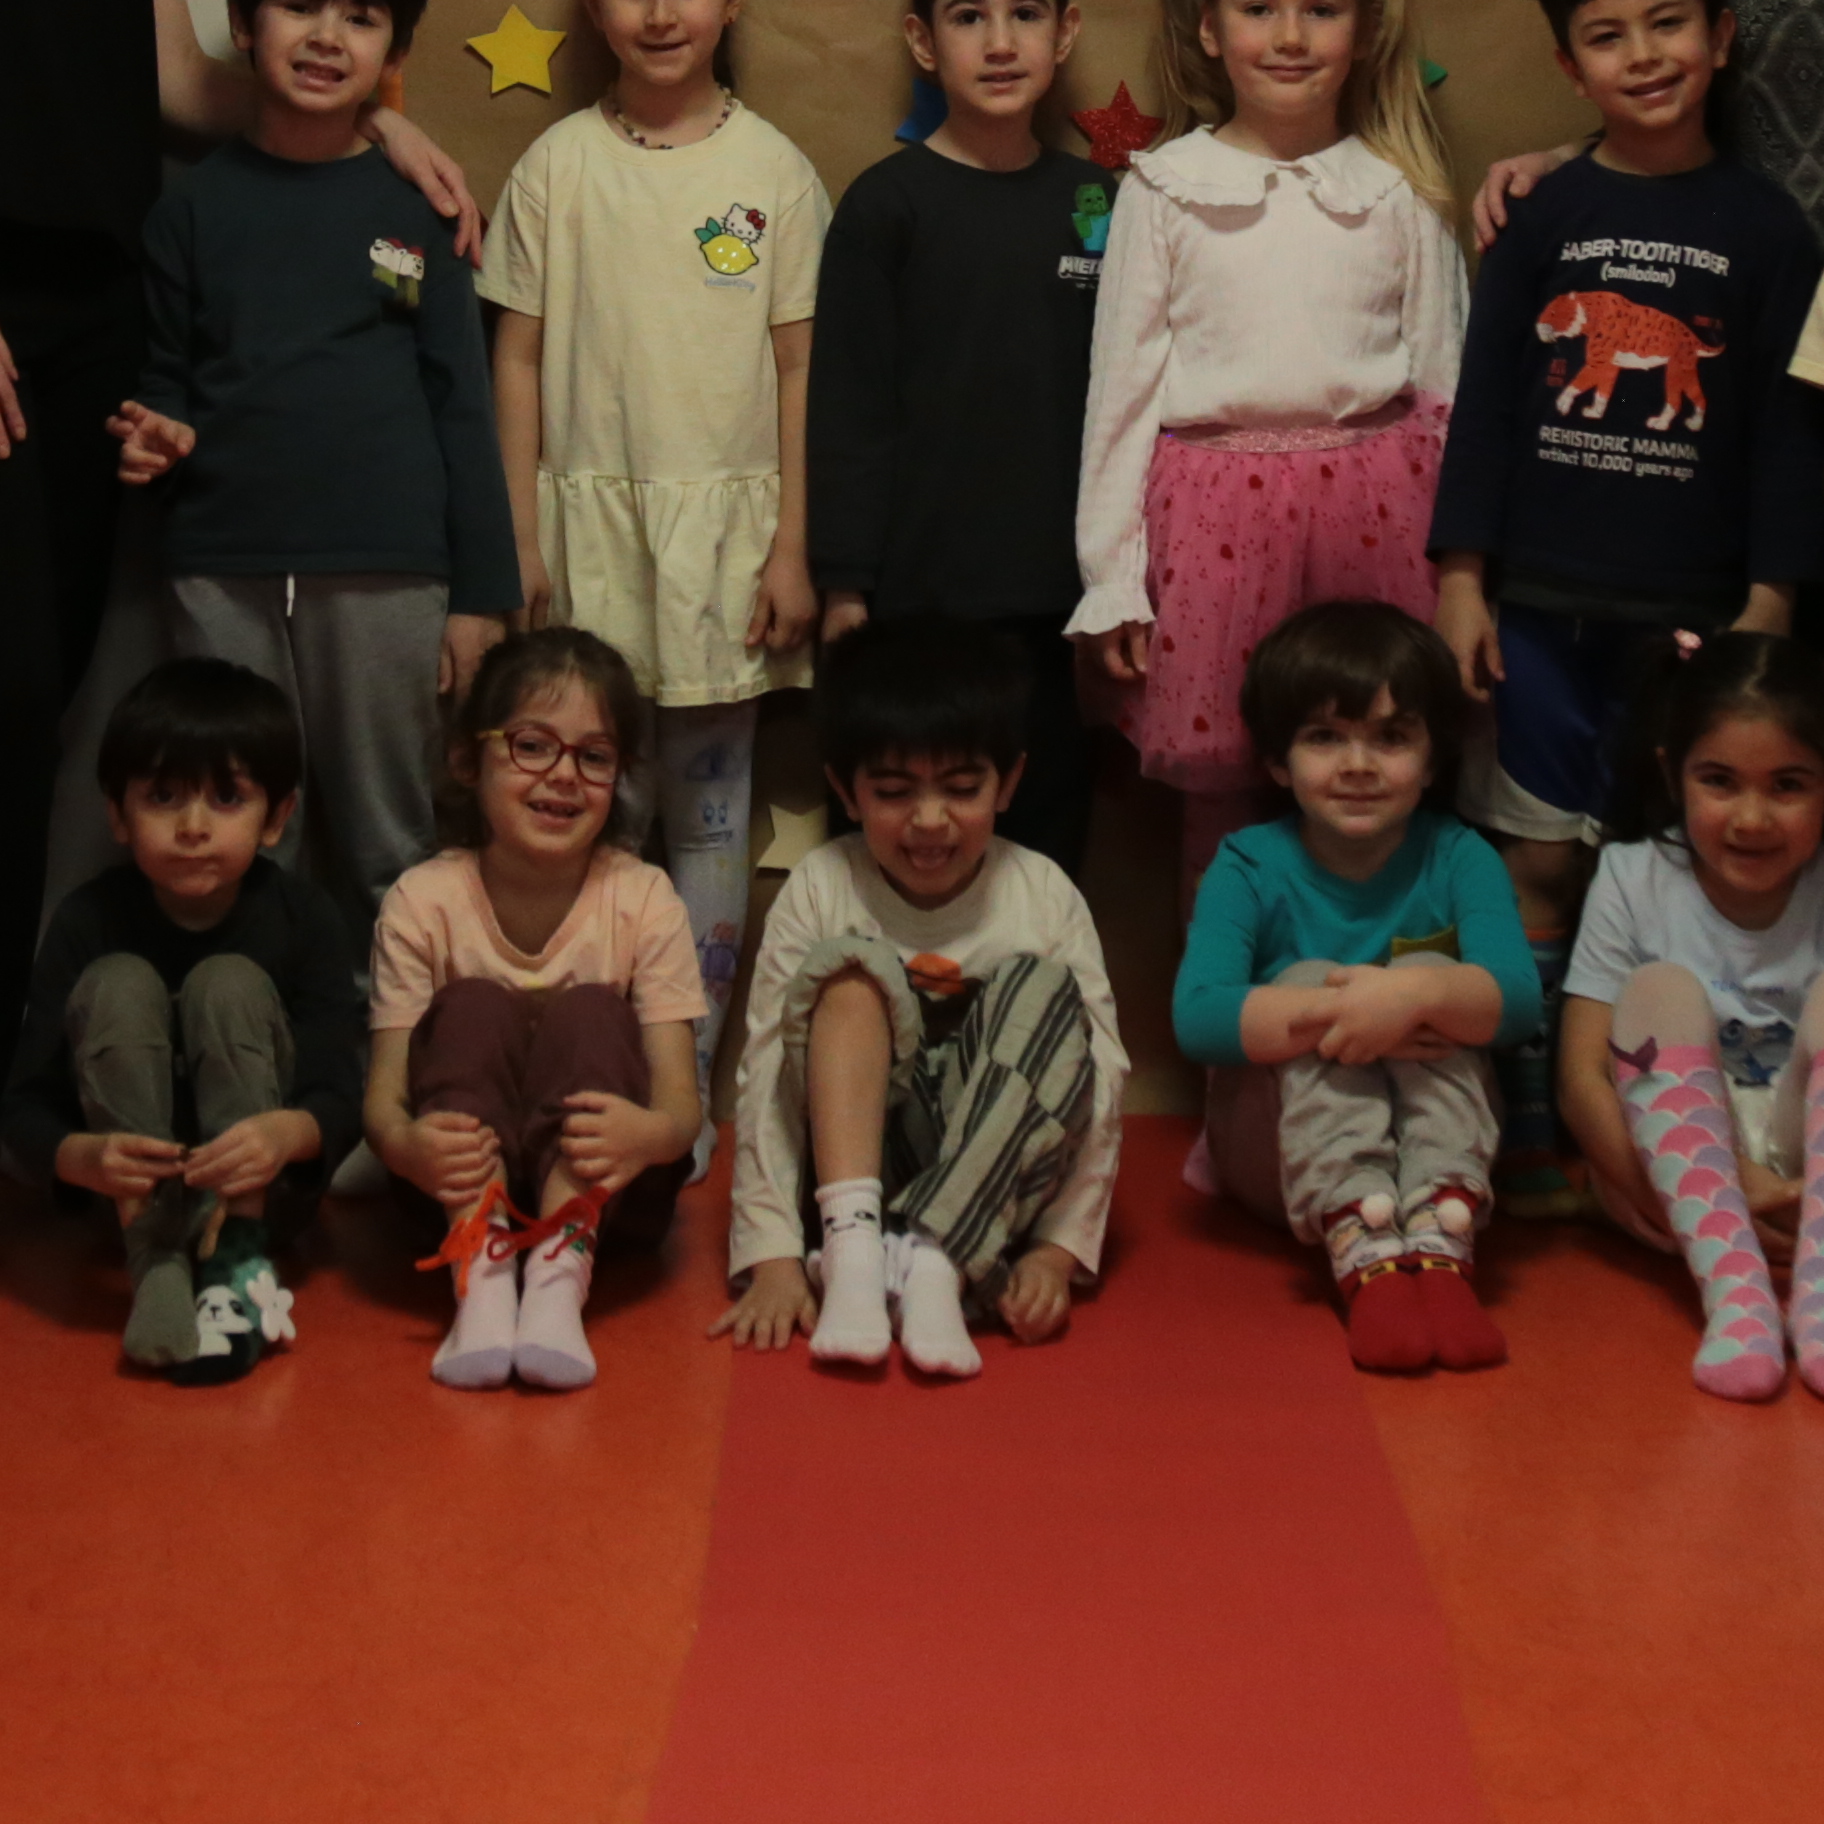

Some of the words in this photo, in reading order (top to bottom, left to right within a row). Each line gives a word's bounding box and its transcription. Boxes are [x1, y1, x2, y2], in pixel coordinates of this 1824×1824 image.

[1683, 245, 1731, 277] TIGER
[1538, 425, 1630, 453] REHISTORIC
[1632, 437, 1700, 462] MAMMA
